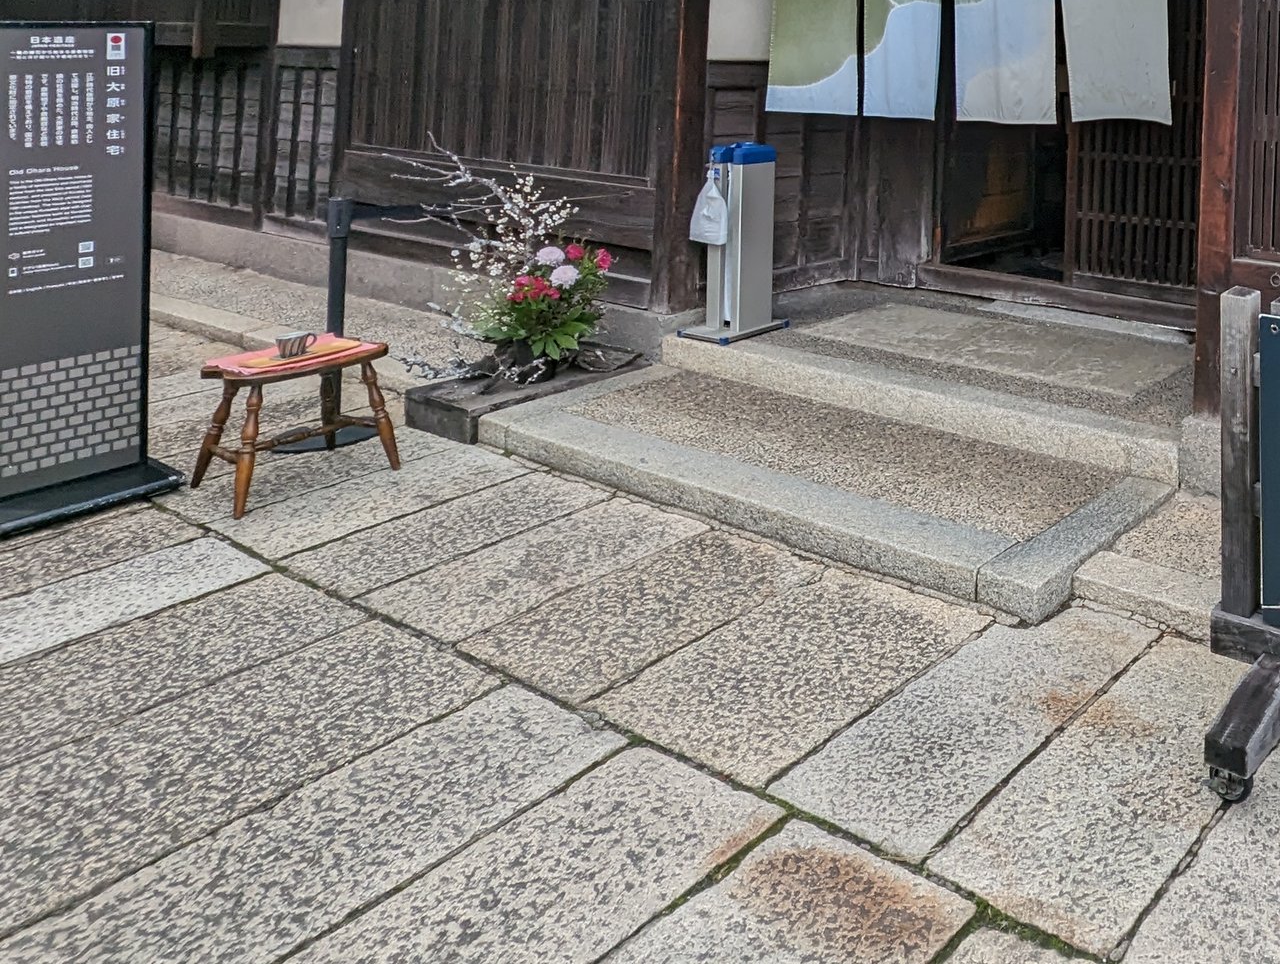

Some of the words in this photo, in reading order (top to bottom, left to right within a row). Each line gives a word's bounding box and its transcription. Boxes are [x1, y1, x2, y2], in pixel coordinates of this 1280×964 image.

[106, 66, 121, 155] 旧大原家住宅
